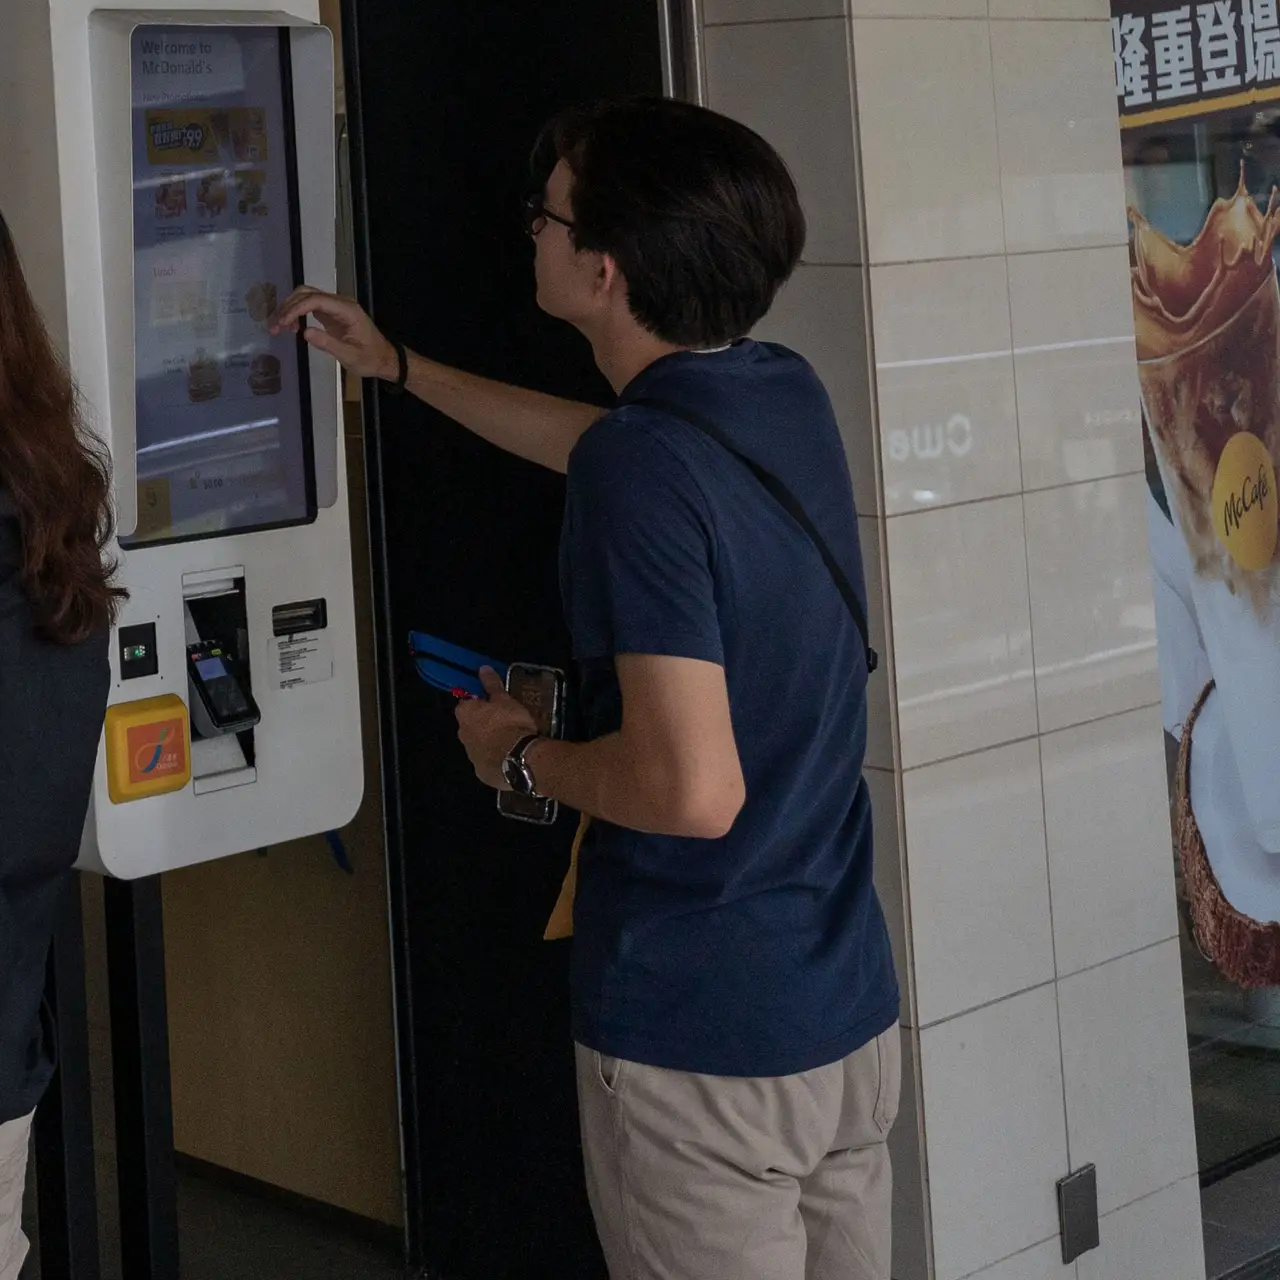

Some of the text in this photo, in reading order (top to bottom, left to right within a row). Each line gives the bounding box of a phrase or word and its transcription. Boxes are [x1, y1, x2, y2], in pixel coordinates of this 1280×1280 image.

[141, 39, 212, 55] Welcome to
[142, 60, 212, 75] McDonald's
[1224, 464, 1269, 537] McCafé
